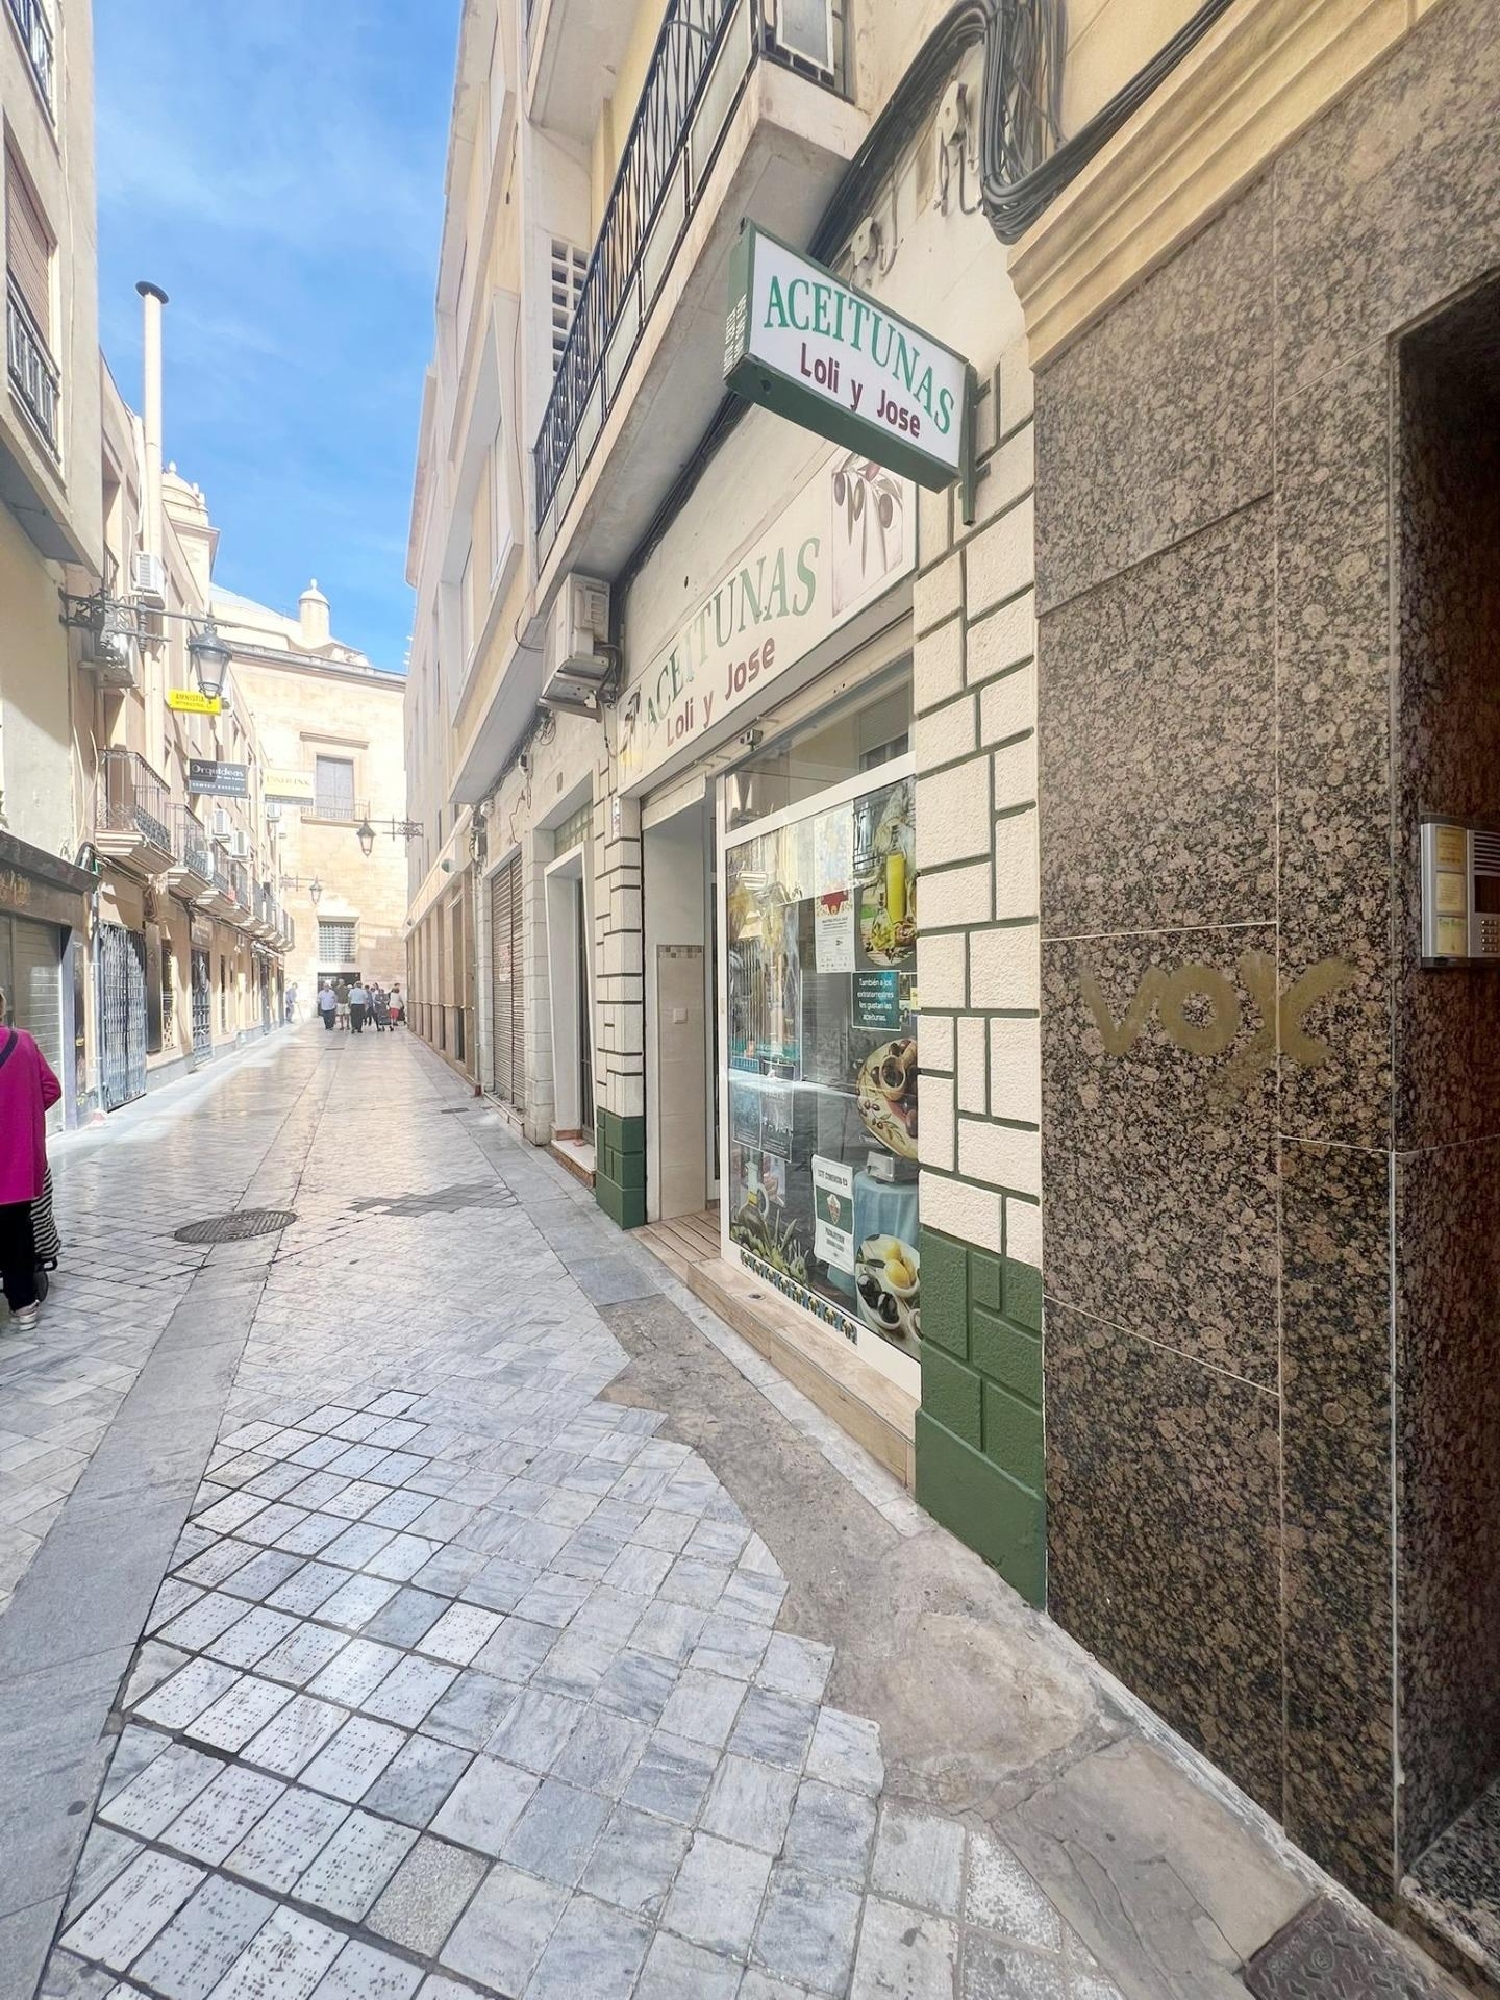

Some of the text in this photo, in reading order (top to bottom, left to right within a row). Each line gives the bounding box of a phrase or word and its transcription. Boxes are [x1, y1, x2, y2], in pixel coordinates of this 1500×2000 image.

[764, 275, 955, 434] ACEITUNAS
[800, 342, 921, 439] Loli y Jose
[644, 537, 821, 732] ACEITUNAS
[667, 637, 776, 748] Loli y Jose
